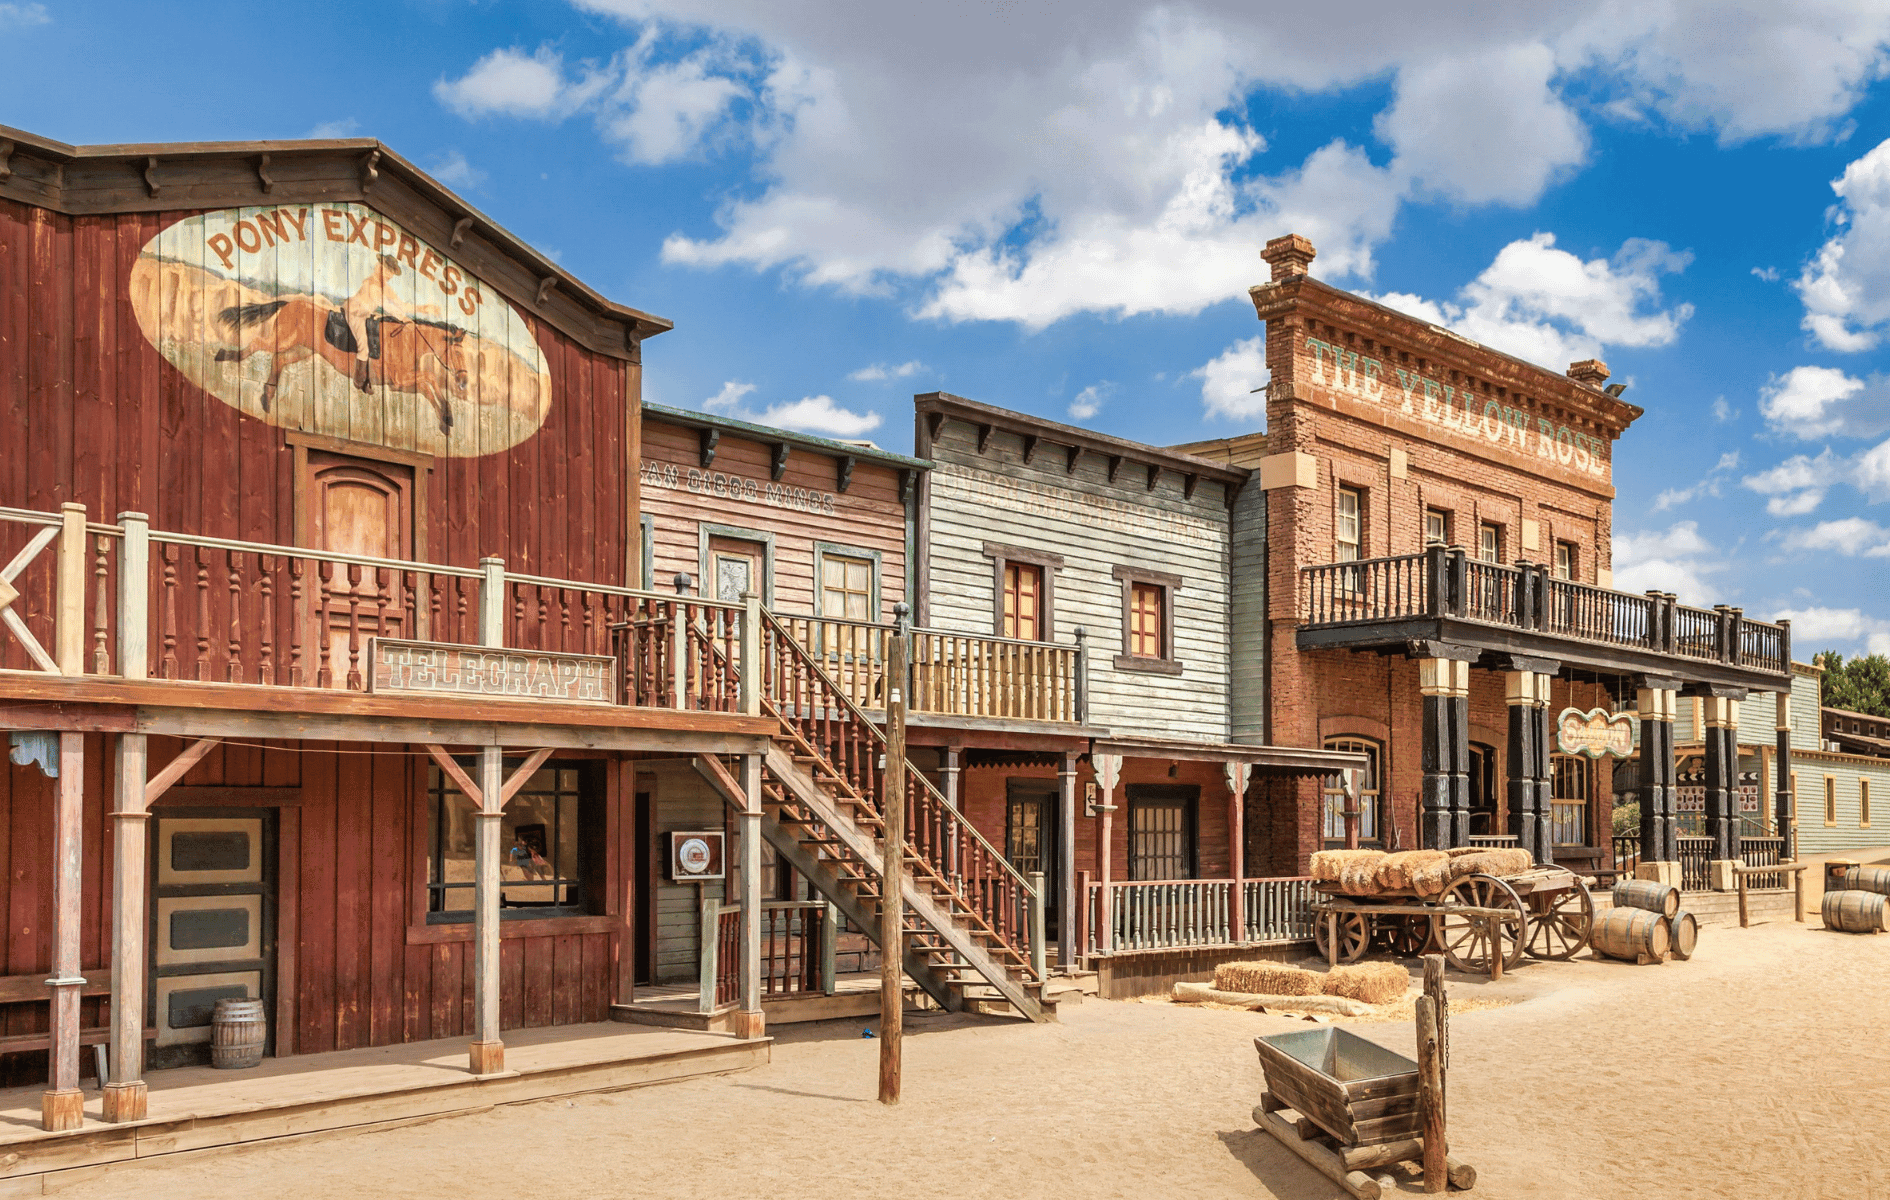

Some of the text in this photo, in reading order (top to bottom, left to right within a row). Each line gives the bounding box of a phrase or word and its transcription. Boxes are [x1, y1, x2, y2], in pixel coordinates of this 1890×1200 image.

[207, 208, 483, 316] PONY EXPRESS
[1304, 337, 1605, 475] THE YELLOW ROSE
[687, 468, 757, 502] DIEGO
[765, 483, 834, 516] MINES
[383, 646, 603, 700] TELEGRAPH
